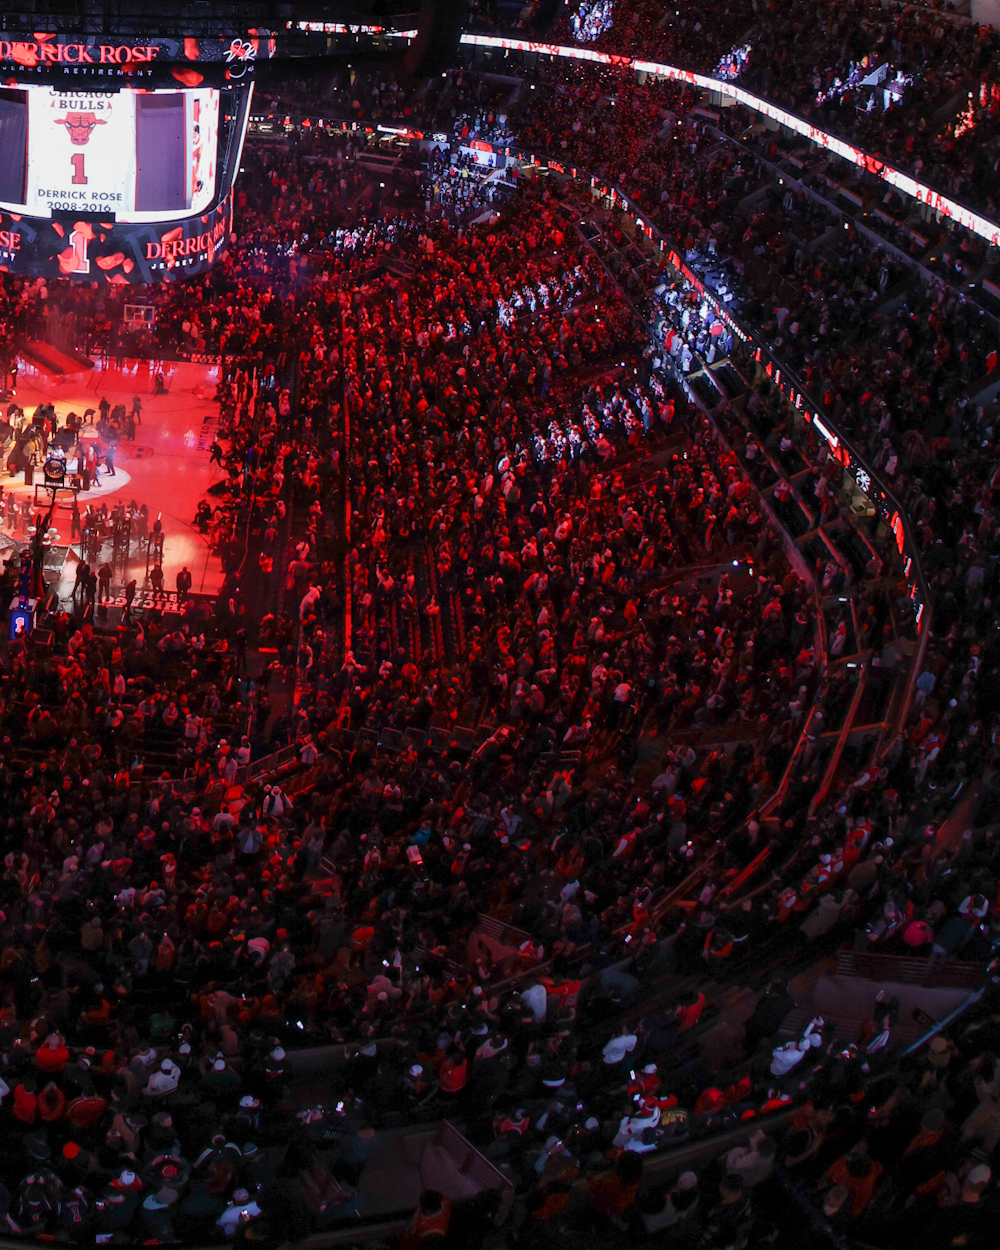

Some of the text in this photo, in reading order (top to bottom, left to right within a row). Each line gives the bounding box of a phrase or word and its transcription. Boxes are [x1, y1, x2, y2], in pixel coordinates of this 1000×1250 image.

[99, 45, 160, 64] ROSE
[59, 100, 105, 110] BULLS
[70, 153, 88, 185] 1
[38, 189, 122, 201] DERRICK ROSE
[47, 201, 112, 212] 2008-2016
